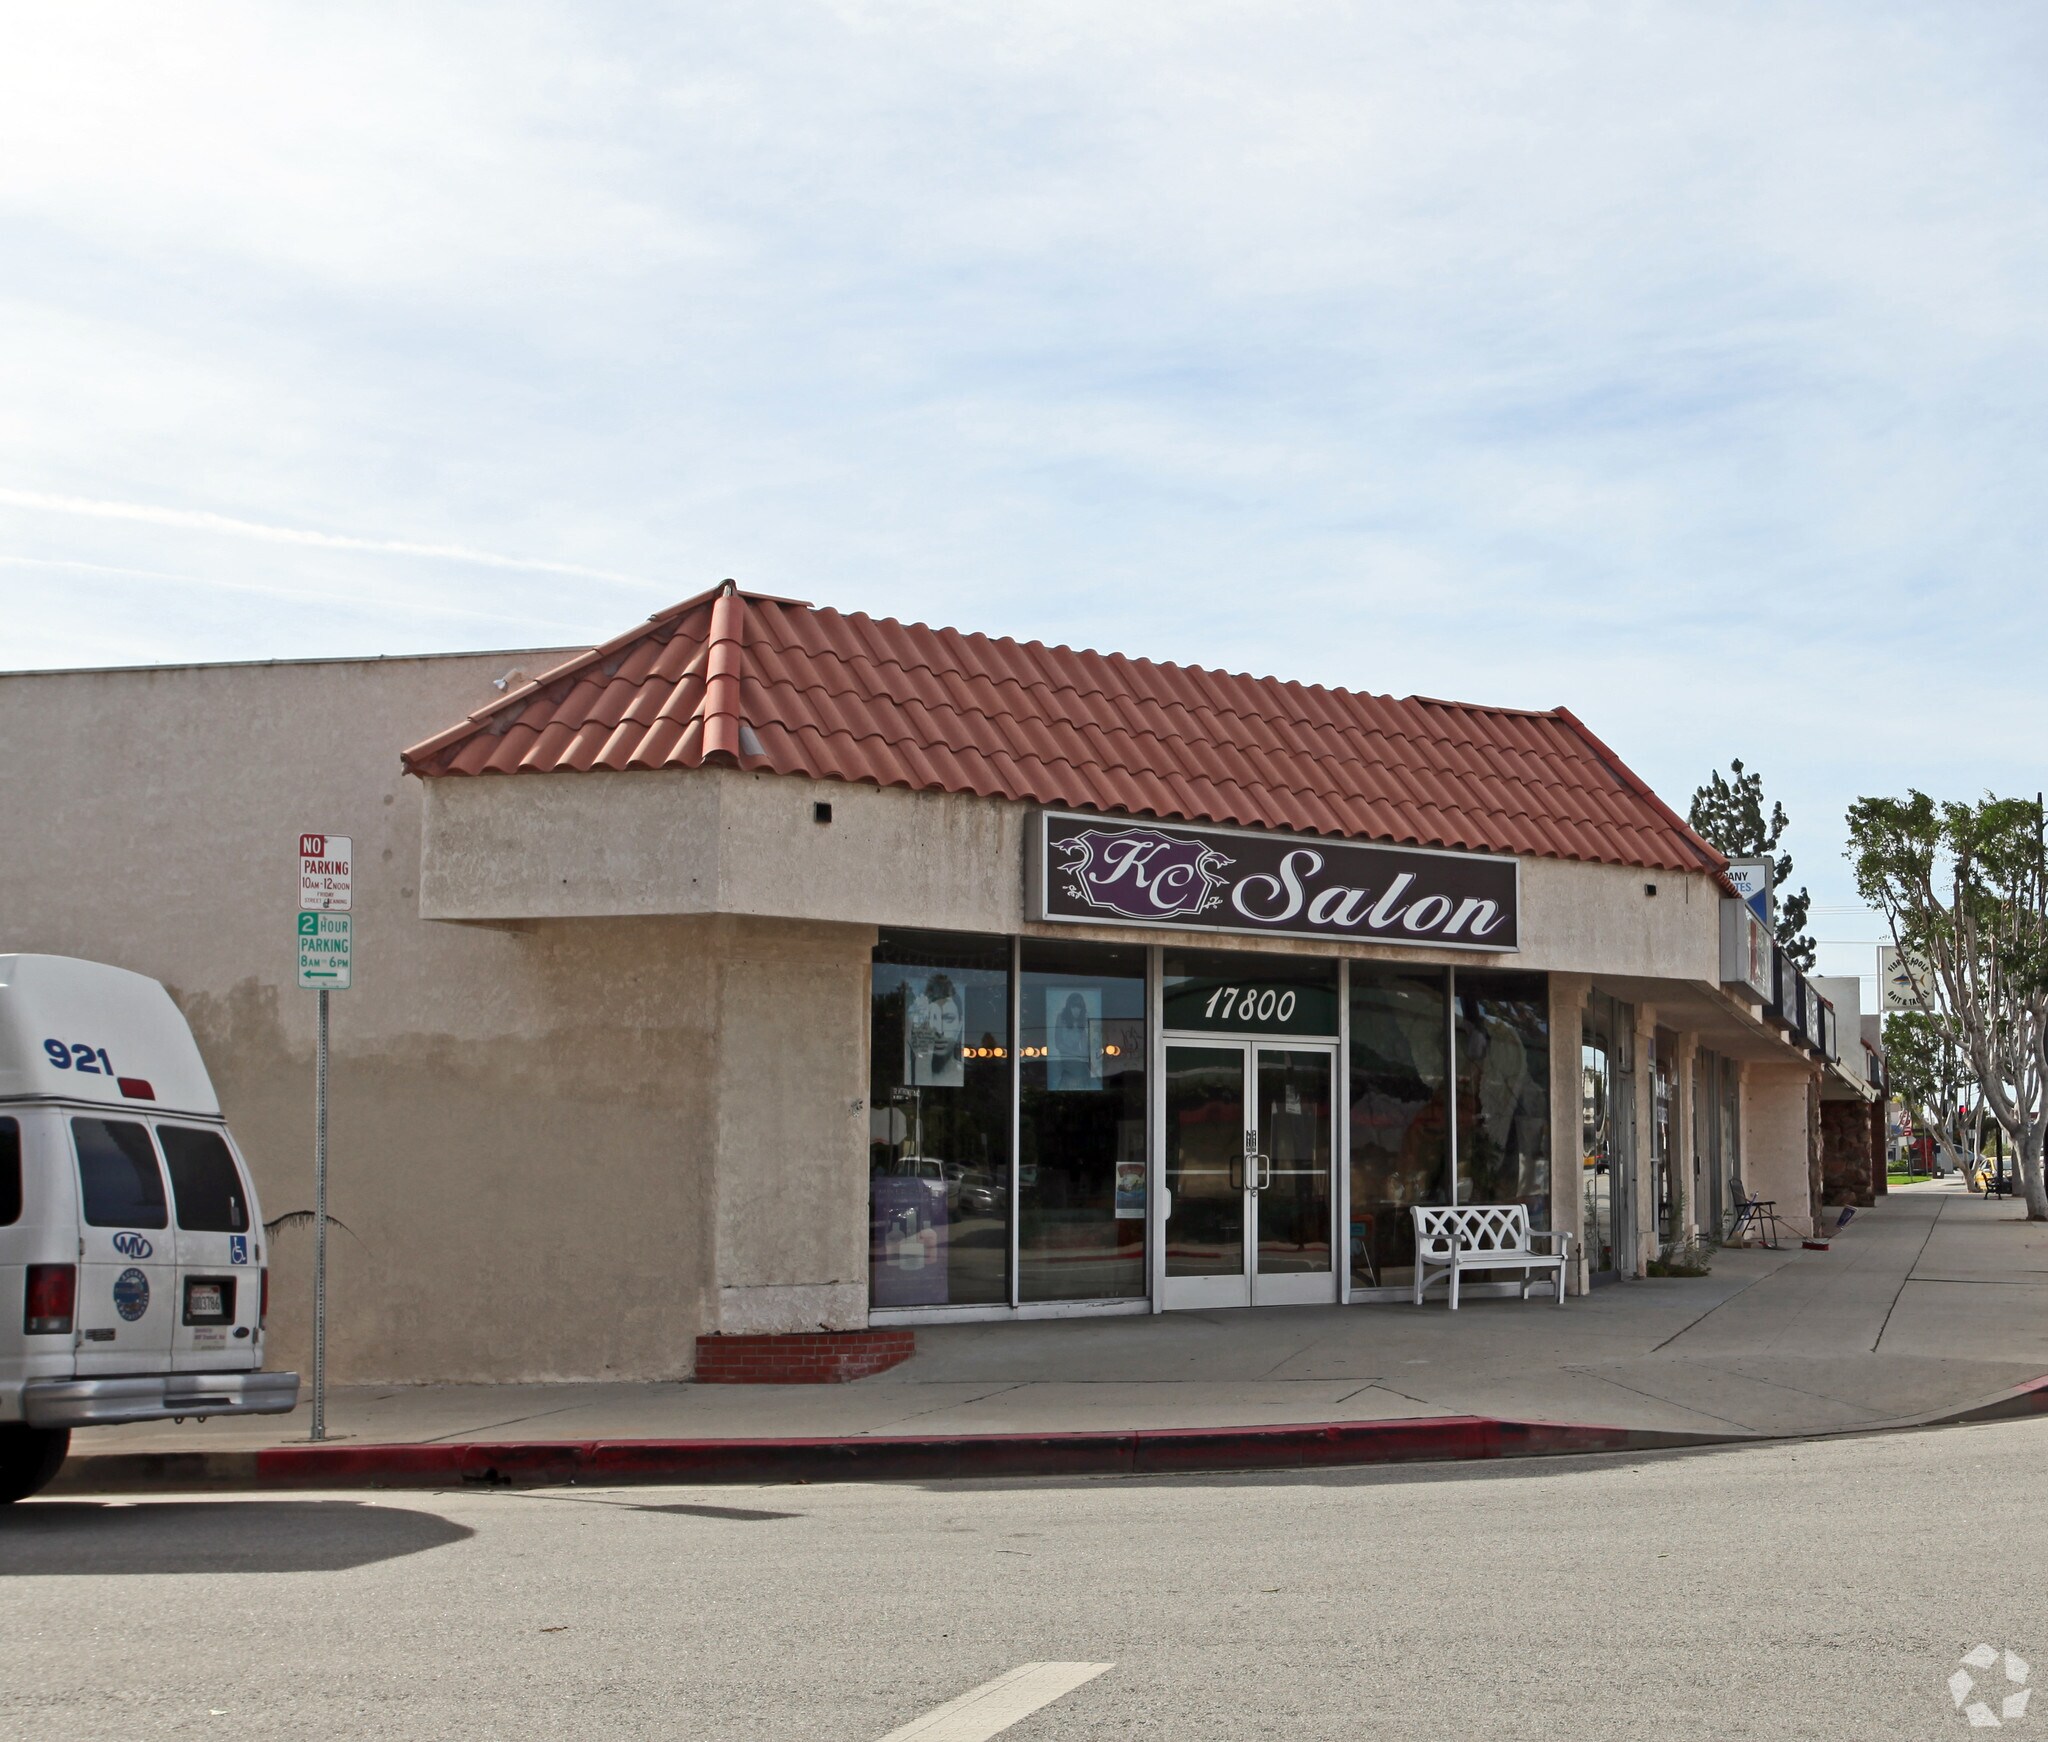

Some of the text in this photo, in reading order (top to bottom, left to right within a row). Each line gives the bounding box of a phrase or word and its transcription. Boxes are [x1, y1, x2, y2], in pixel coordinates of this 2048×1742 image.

[303, 837, 321, 854] NO
[304, 860, 349, 875] PARKING
[1089, 838, 1506, 936] KC Salon
[302, 915, 348, 933] 2 HOUR
[301, 938, 349, 953] PARKING
[1205, 987, 1296, 1022] 17800
[1887, 990, 1902, 1004] BAIT
[1908, 989, 1930, 1006] TACLE
[43, 1038, 115, 1076] 921
